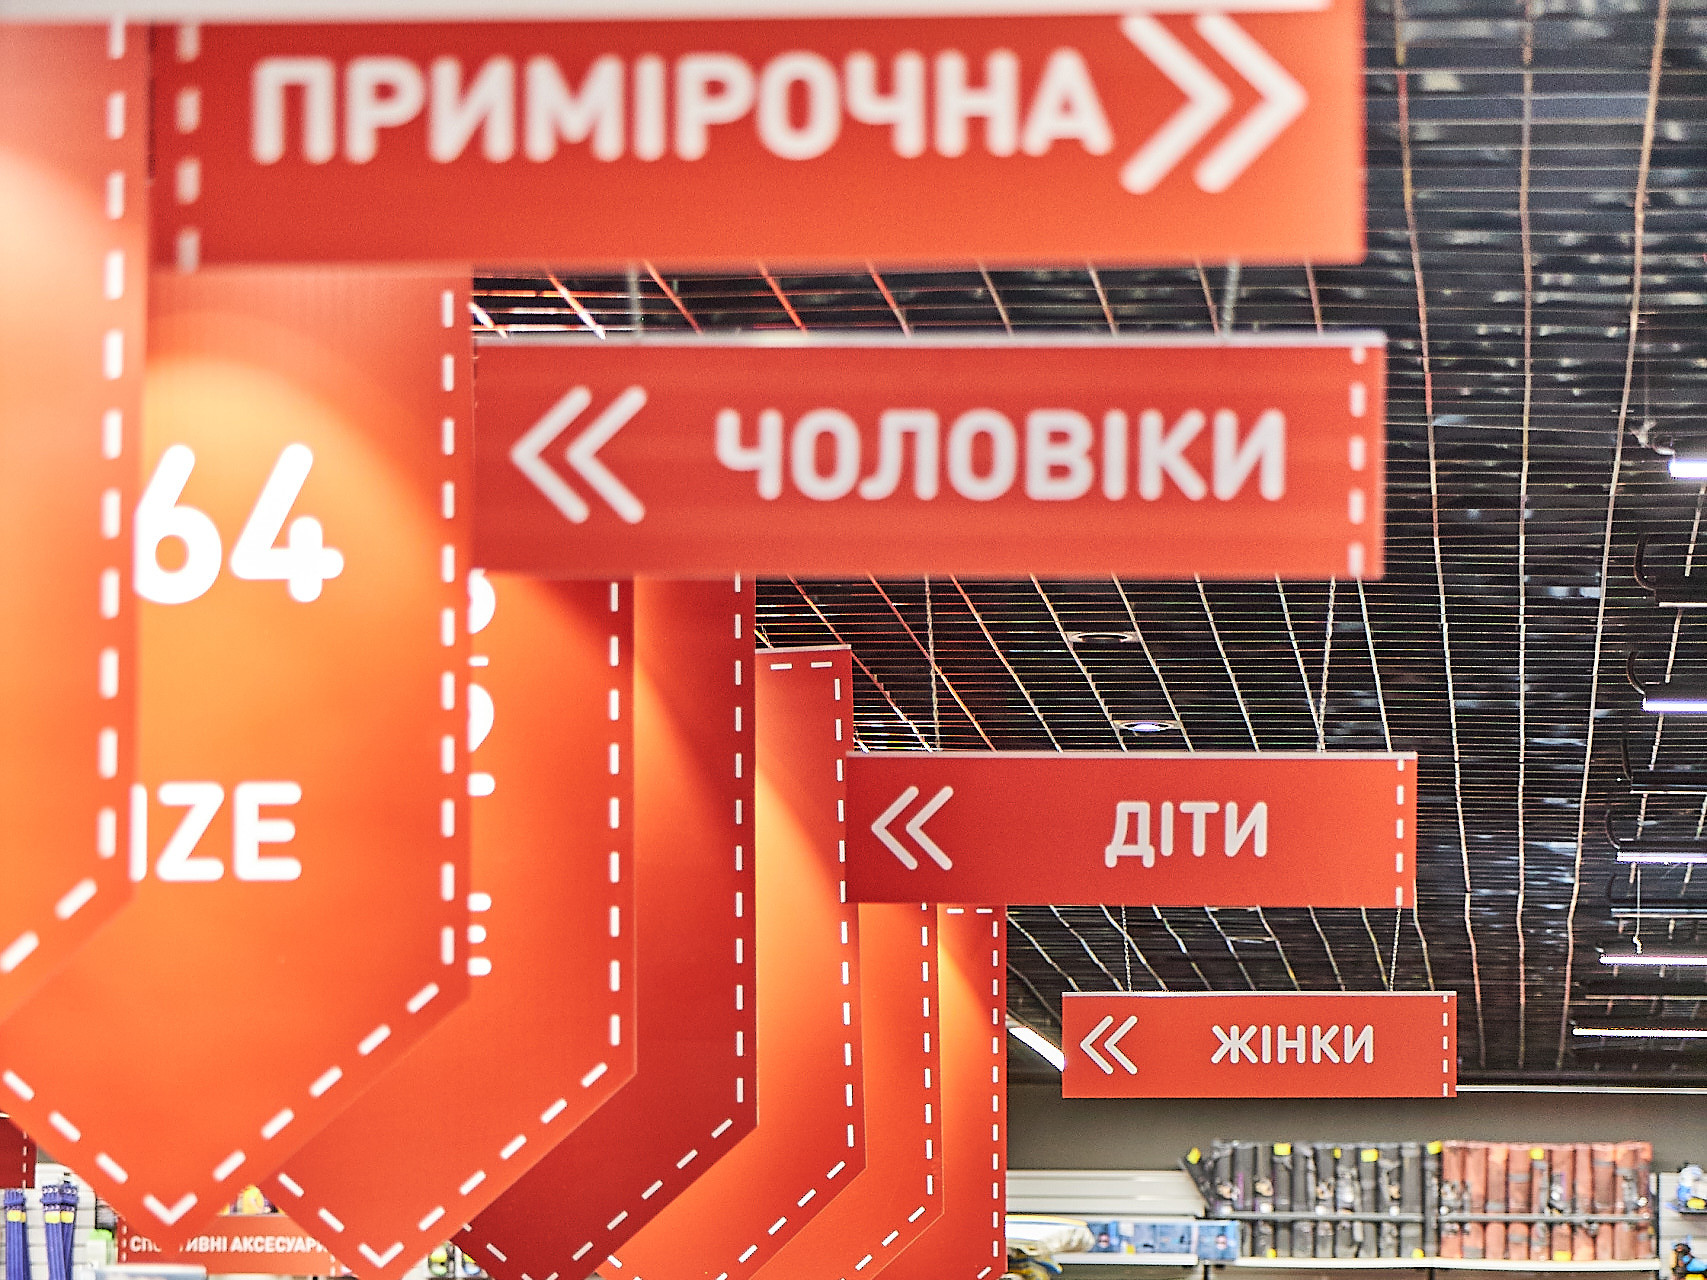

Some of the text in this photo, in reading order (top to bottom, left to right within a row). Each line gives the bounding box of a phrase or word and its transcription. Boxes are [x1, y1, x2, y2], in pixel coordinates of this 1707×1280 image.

[250, 48, 1115, 165] ПРИМІРОЧНА
[714, 408, 1288, 503] ЧОЛОВІКИ
[133, 440, 345, 606] 64
[1104, 800, 1269, 869] ДІТИ
[1210, 1023, 1375, 1065] ЖІНКИ
[129, 1235, 228, 1253] СПИВНІ
